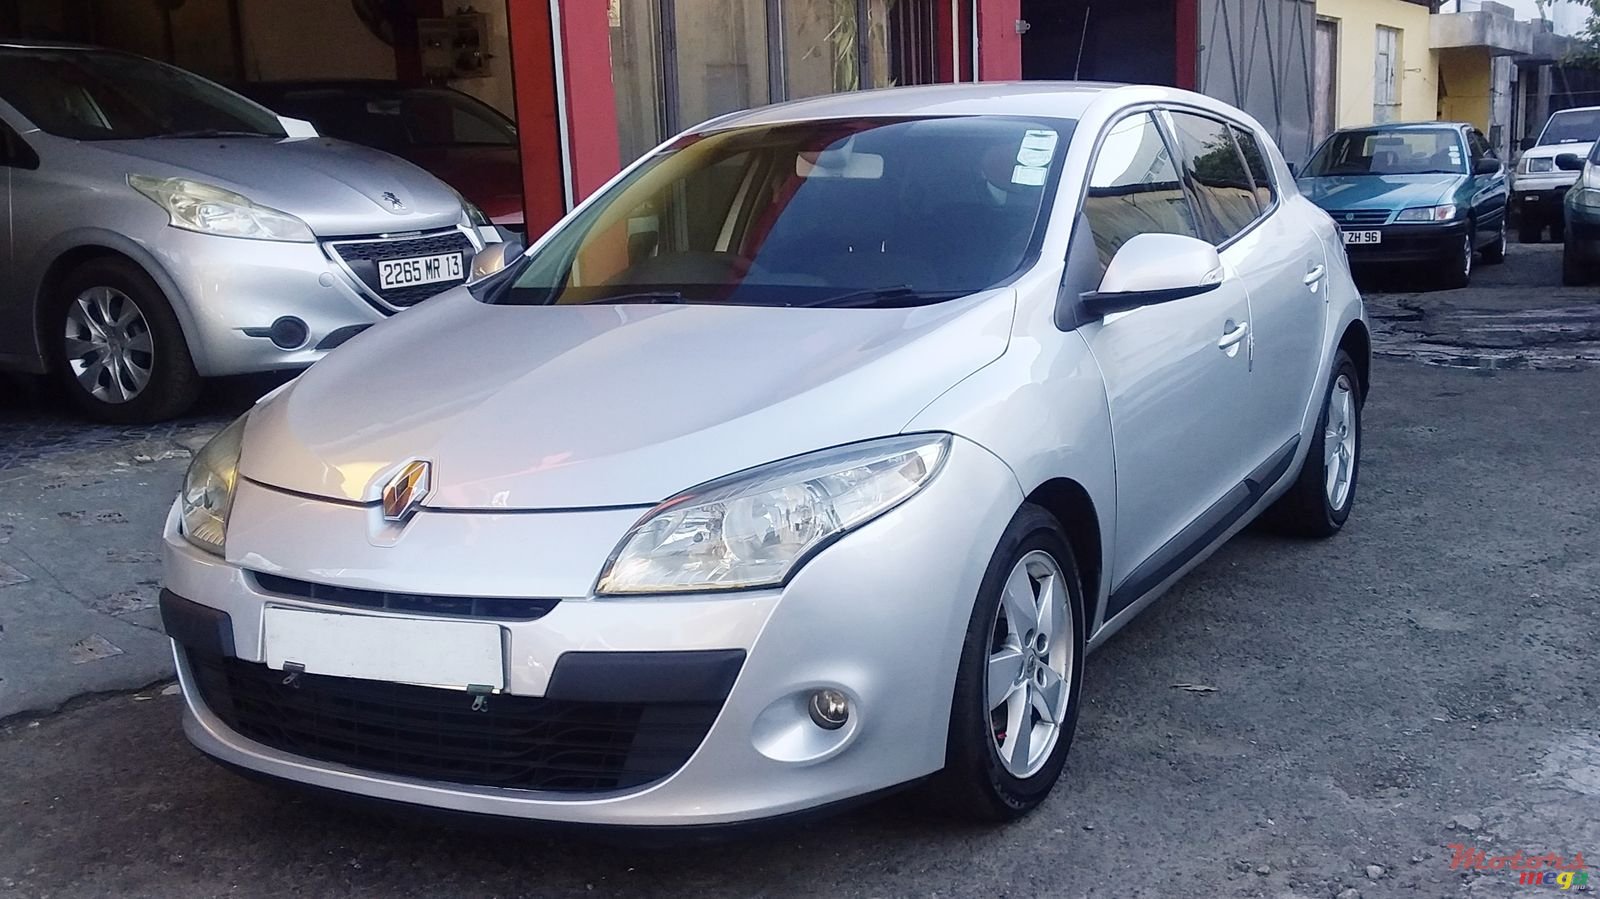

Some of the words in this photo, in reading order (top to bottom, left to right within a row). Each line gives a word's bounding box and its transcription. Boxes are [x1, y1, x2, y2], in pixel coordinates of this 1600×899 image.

[1348, 232, 1361, 242] ZH
[1364, 231, 1377, 242] 96
[384, 261, 421, 285] 2265
[425, 258, 440, 280] MR
[446, 255, 459, 276] 13
